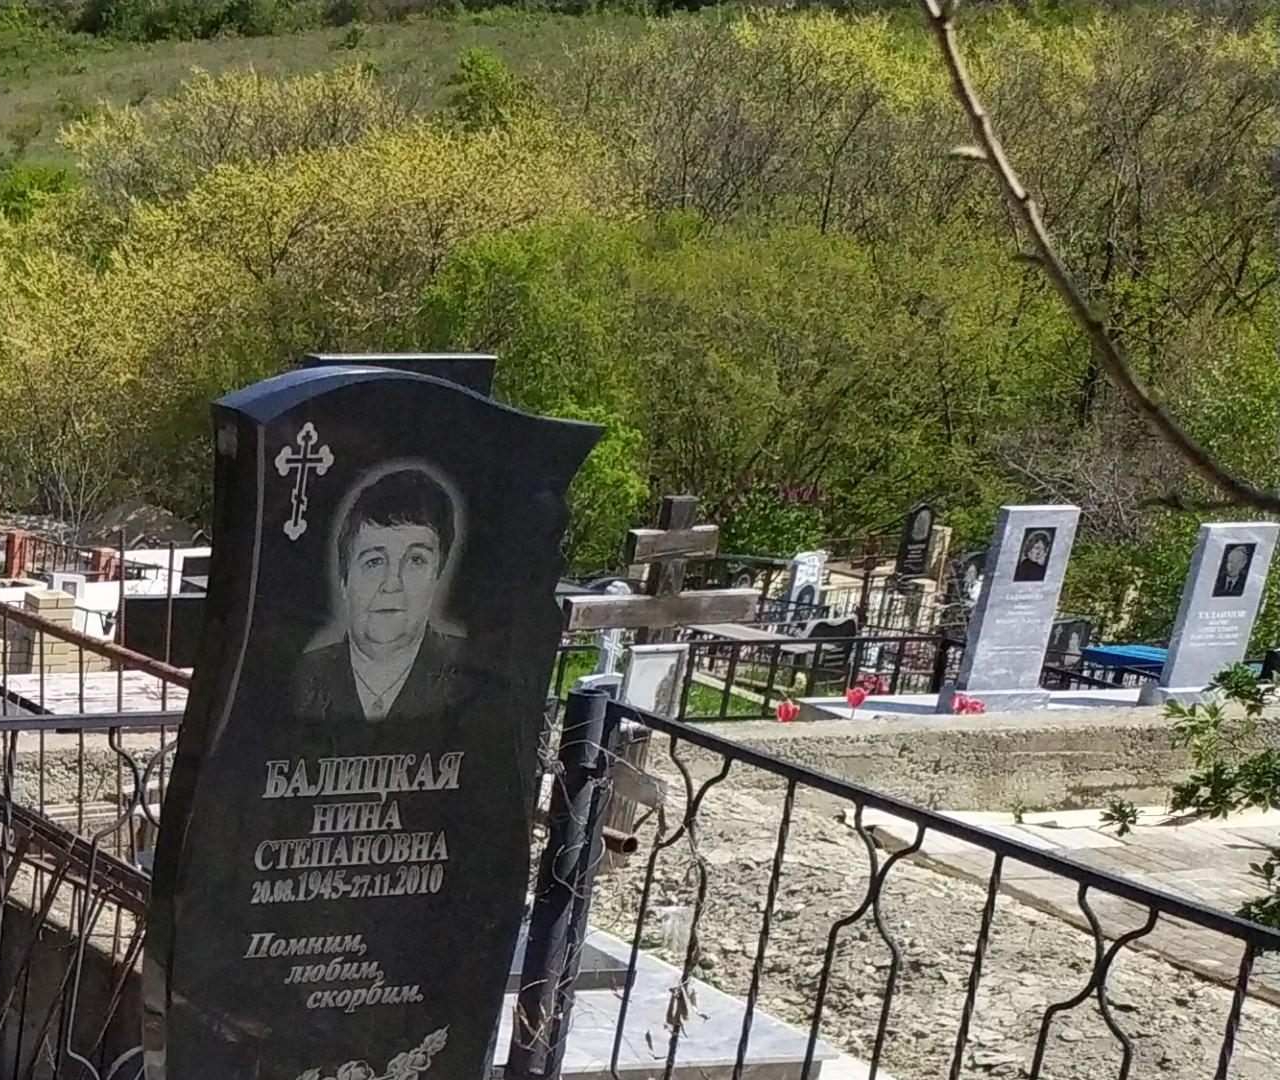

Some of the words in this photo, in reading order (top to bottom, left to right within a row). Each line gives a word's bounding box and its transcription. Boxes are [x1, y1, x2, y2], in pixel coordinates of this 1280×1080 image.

[262, 752, 464, 803] БАЛИЦКАЯ
[310, 801, 402, 834] НИНА
[254, 831, 448, 871] СТЕПАНОВНА
[243, 933, 368, 959] Помним,
[284, 957, 384, 984] любим,
[306, 981, 424, 1013] скорбим.
